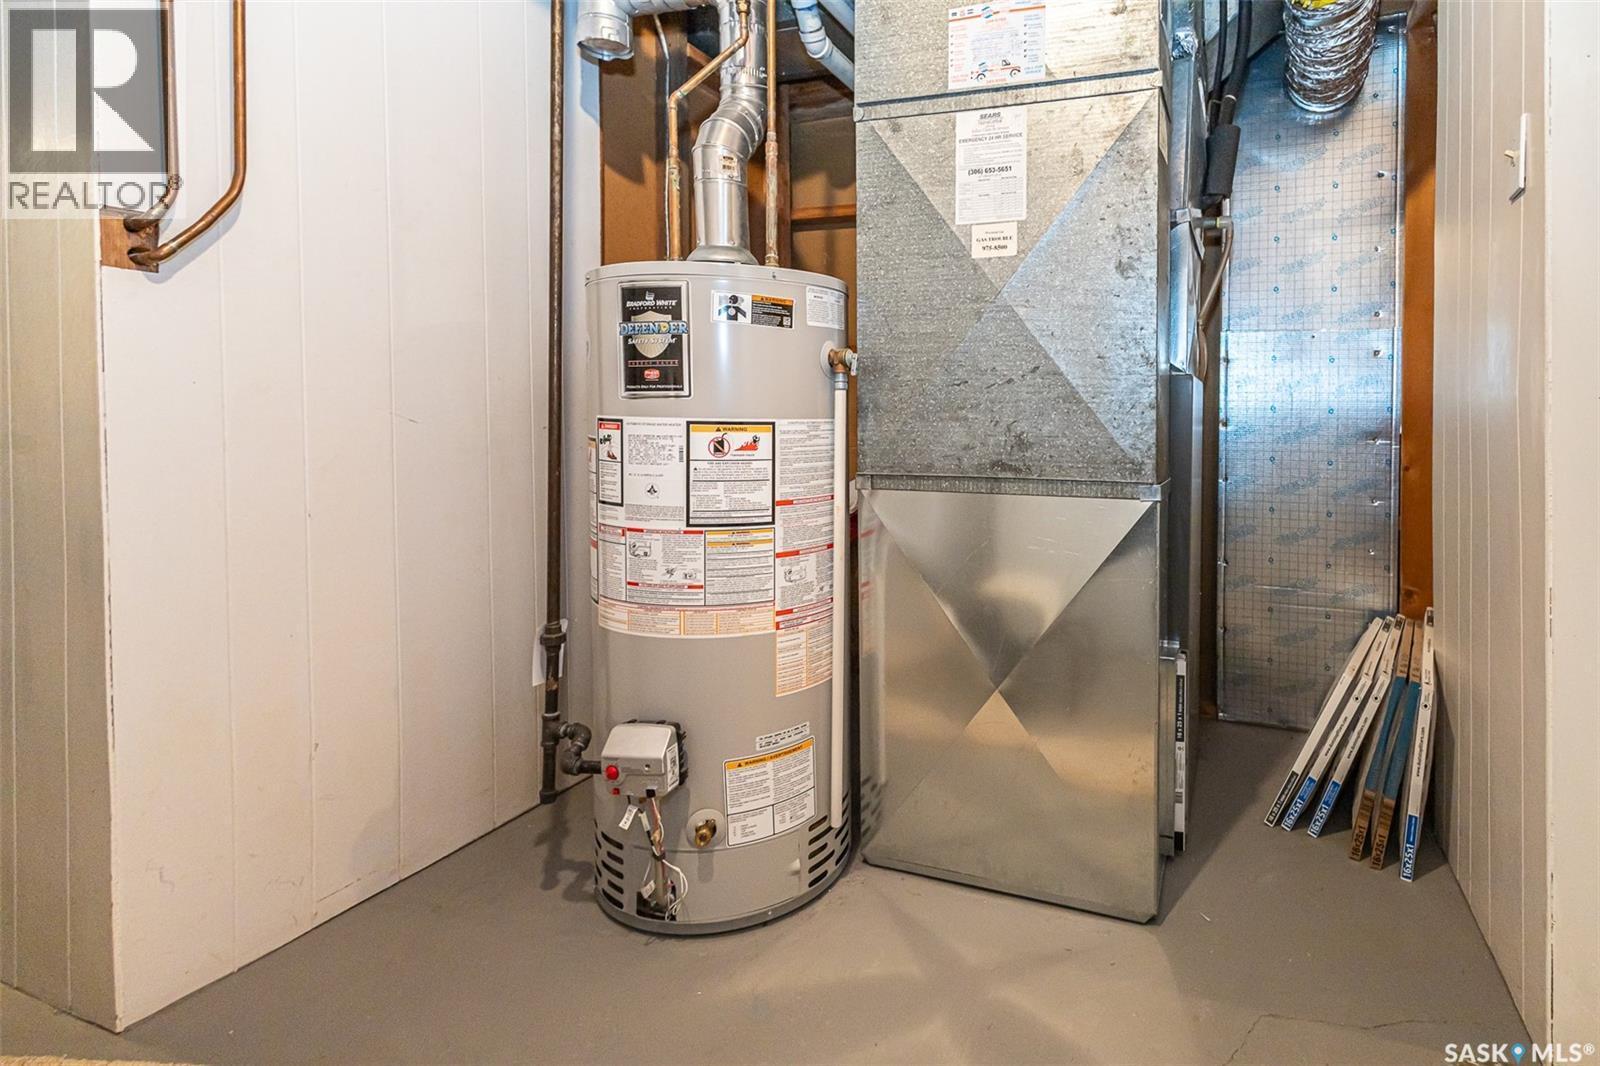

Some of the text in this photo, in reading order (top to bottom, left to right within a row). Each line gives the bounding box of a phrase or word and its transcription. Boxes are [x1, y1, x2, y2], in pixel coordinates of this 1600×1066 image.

[968, 167, 984, 176] (306)
[619, 320, 688, 335] DEFENDER
[1284, 798, 1304, 827] 16x25x1
[1310, 804, 1329, 834] 16x25x1
[1402, 843, 1414, 877] 16x25x1
